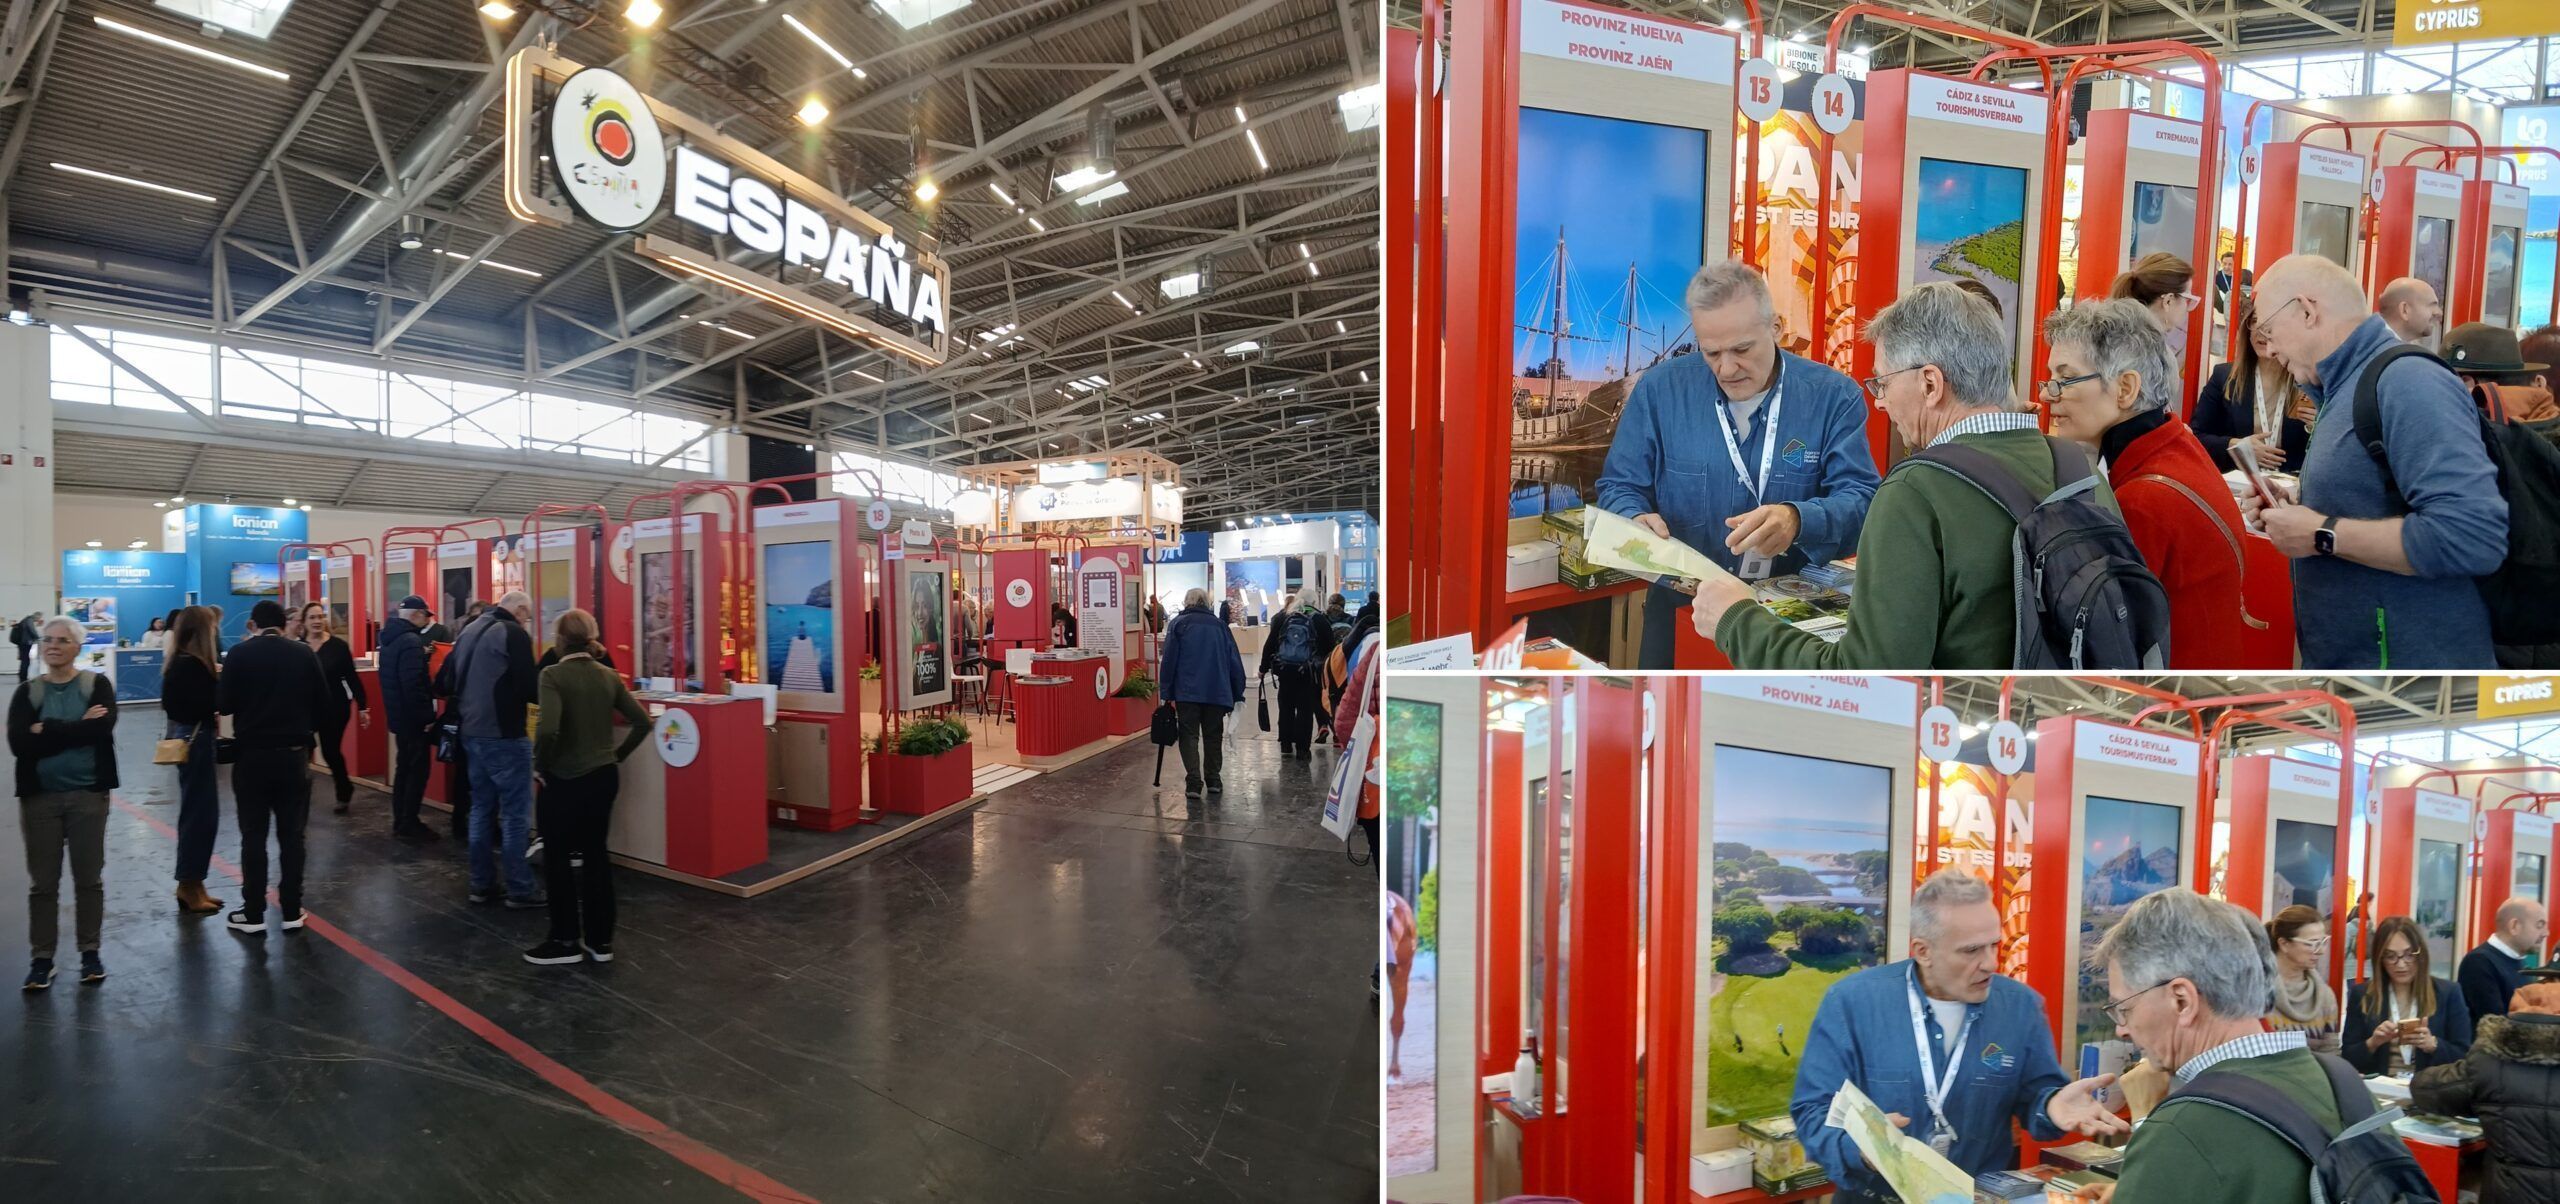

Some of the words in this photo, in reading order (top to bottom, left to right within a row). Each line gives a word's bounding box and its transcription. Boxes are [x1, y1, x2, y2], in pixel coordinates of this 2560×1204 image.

[1562, 10, 1627, 34] PROVINZ
[1631, 23, 1684, 45] HUELVA
[2415, 6, 2480, 32] CYPRUS
[1568, 42, 1633, 65] PROVINZ
[1637, 55, 1673, 72] JAÉN
[1786, 48, 1818, 62] BIBIONE
[1786, 60, 1817, 73] JESOLO
[1749, 76, 1771, 104] 13
[1946, 88, 1973, 102] CÁDIZ
[1974, 93, 1981, 103] &
[1982, 95, 2015, 109] SEVILLA
[1823, 90, 1844, 117] 14
[1936, 102, 2023, 123] TOURISMUSVERBAND
[2155, 130, 2199, 145] EXTREMADURA
[2245, 156, 2255, 174] 16
[2517, 169, 2548, 182] YPRUS
[2375, 178, 2382, 193] 17
[1789, 208, 1819, 228] ES
[1828, 211, 1861, 230] DIR
[675, 145, 945, 335] ESPAÑA
[232, 514, 279, 530] Ionian
[872, 509, 884, 522] 18
[916, 663, 937, 676] 100%
[1762, 686, 1823, 707] PROVINZ
[1826, 699, 1859, 713] JAÉN
[2494, 681, 2552, 704] CYPRUS
[1931, 722, 1950, 748] 13
[2109, 734, 2132, 746] CÁDIZ
[2141, 741, 2170, 752] SEVILLA
[1998, 736, 2016, 760] 14
[2100, 746, 2177, 766] TOURISMUSVERBAND
[1974, 851, 1994, 866] ES
